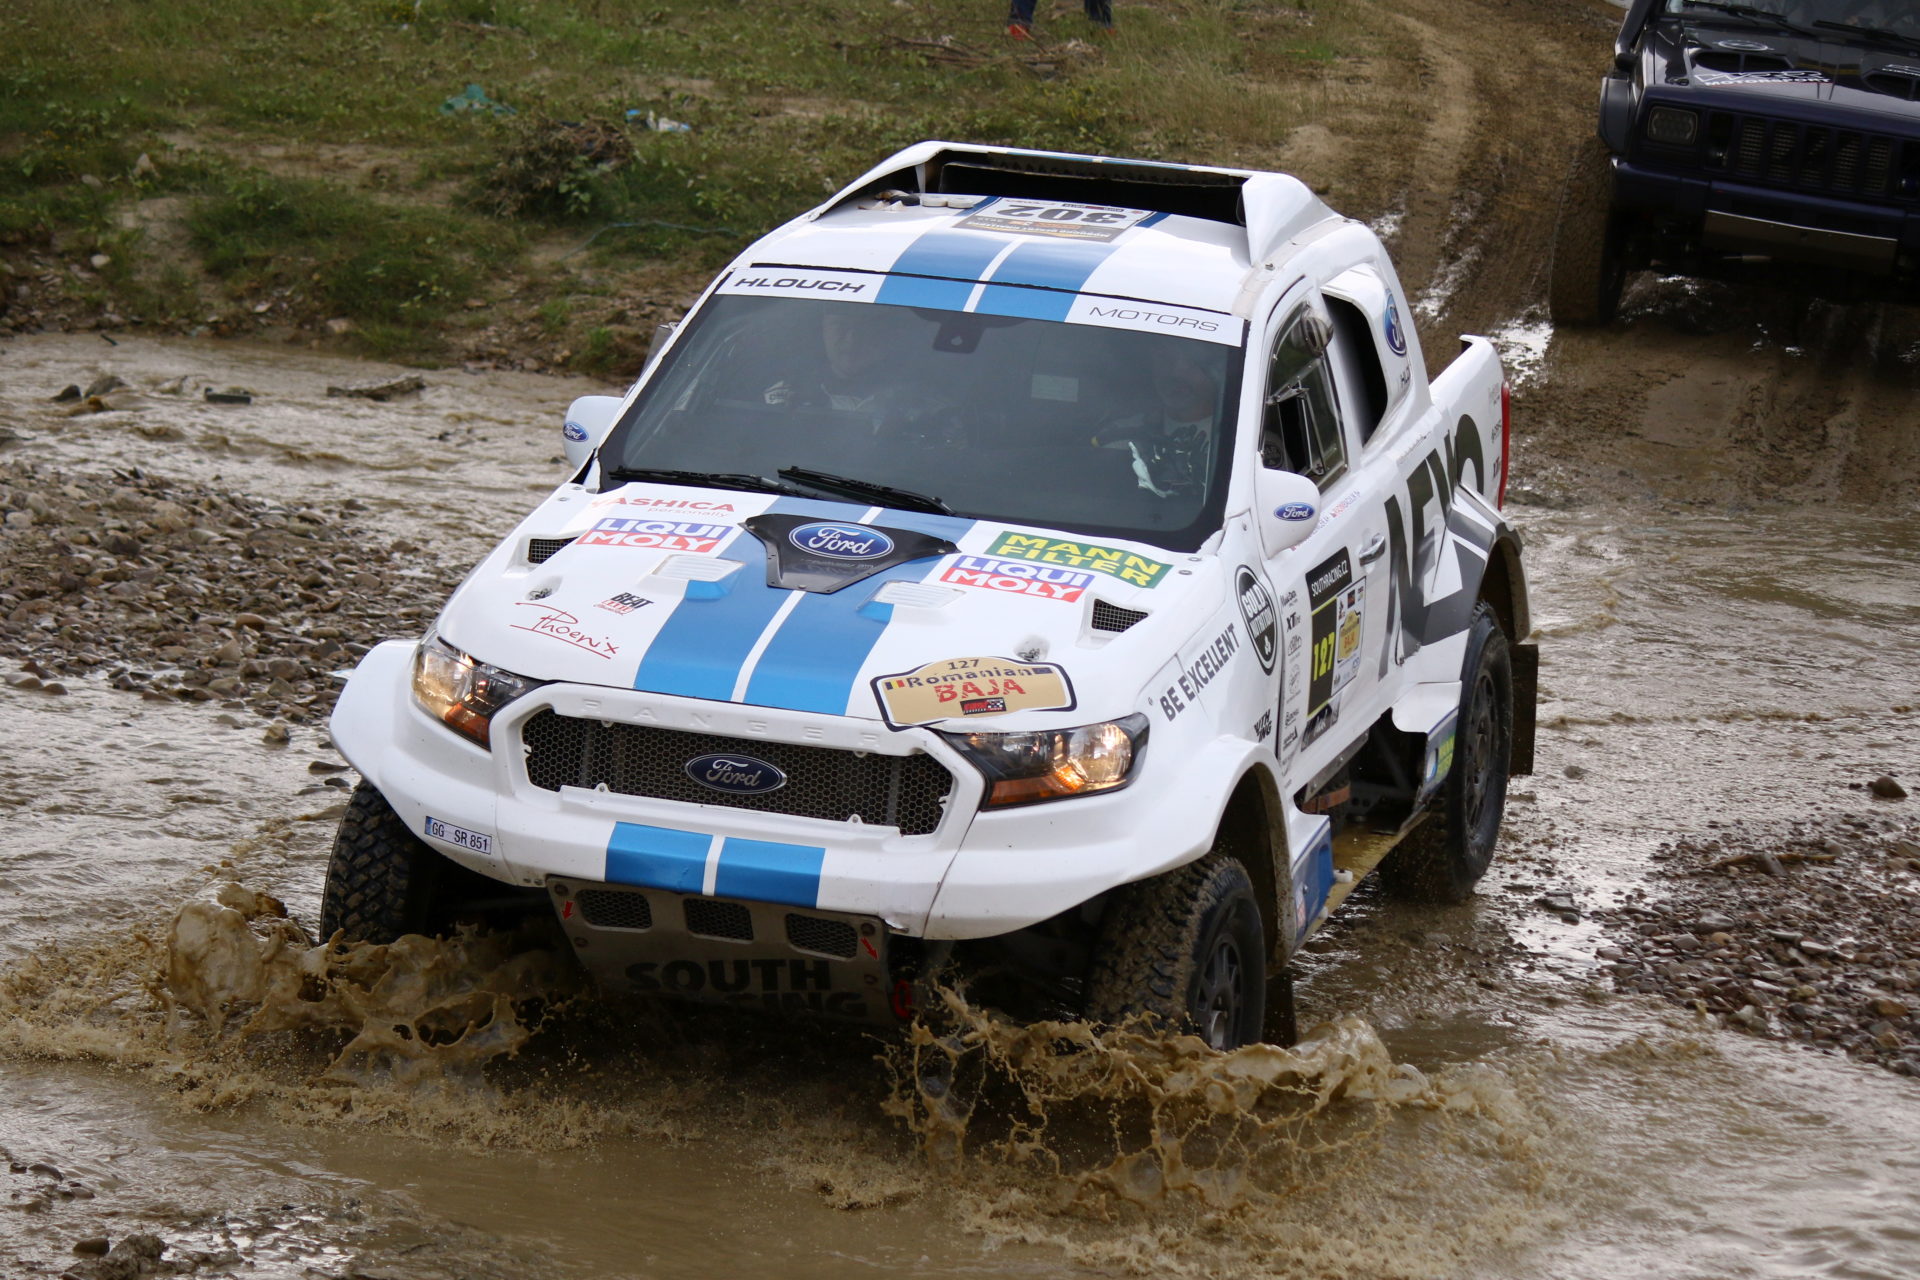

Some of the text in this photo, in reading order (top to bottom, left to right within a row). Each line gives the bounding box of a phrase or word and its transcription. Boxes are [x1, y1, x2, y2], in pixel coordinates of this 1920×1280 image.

[997, 204, 1127, 224] 302
[734, 276, 865, 294] HLOUCH
[1089, 306, 1220, 332] MOTORS
[564, 424, 583, 440] Ford
[647, 507, 729, 518] personally
[582, 531, 720, 551] MOLY
[597, 518, 728, 538] LIQUI
[808, 527, 876, 555] Ford
[996, 545, 1153, 586] FILTER
[1005, 534, 1161, 576] MANN
[946, 568, 1083, 603] MOLY
[963, 556, 1089, 587] LIQUI
[1241, 583, 1269, 619] GOLD
[514, 602, 620, 654] Phoenix
[948, 659, 980, 670] 127
[1314, 631, 1335, 682] 127
[906, 666, 1033, 689] Romanian
[1160, 622, 1239, 722] BE EXCELLENT
[934, 678, 1027, 703] BAJA
[706, 759, 762, 787] Ford
[432, 822, 488, 851] GG SR 851
[624, 959, 832, 992] SOUTH
